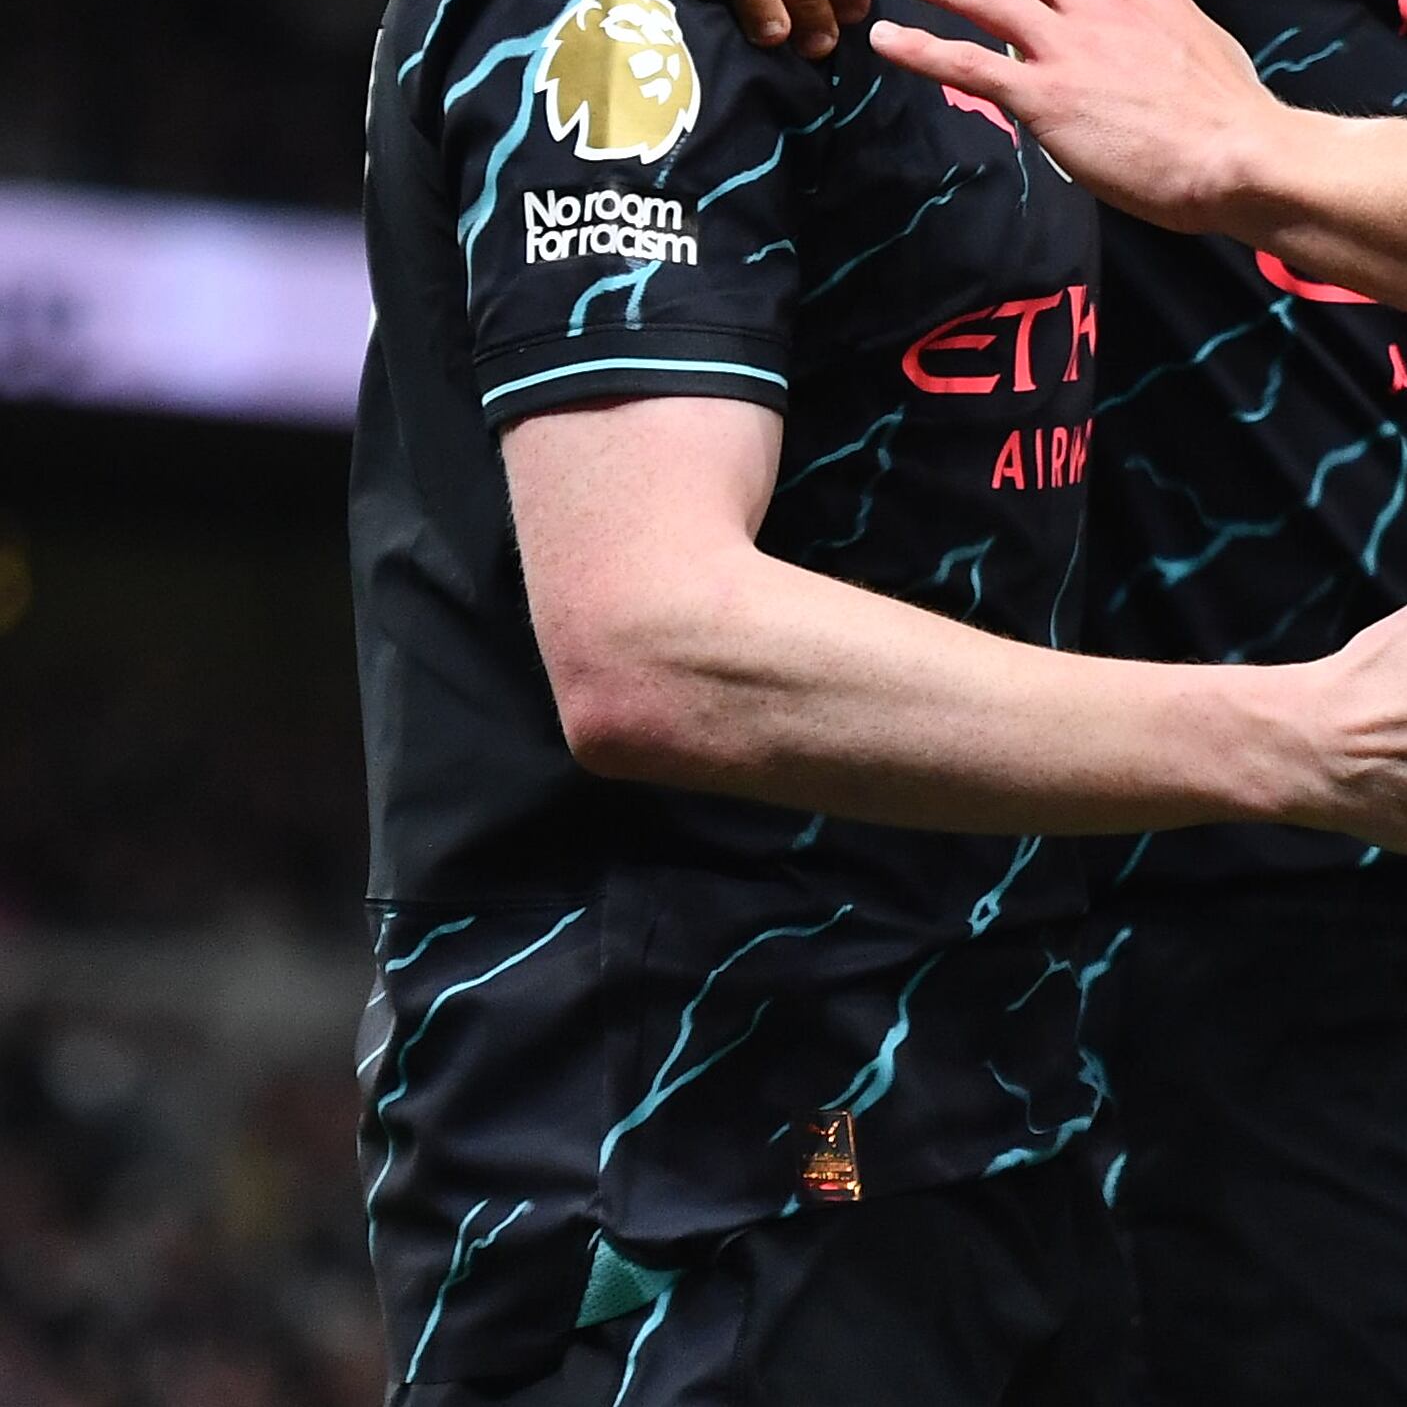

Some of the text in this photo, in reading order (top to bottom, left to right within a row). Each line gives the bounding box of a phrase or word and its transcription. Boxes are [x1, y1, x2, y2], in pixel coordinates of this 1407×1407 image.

[524, 190, 682, 230] No room
[526, 224, 698, 265] for racism
